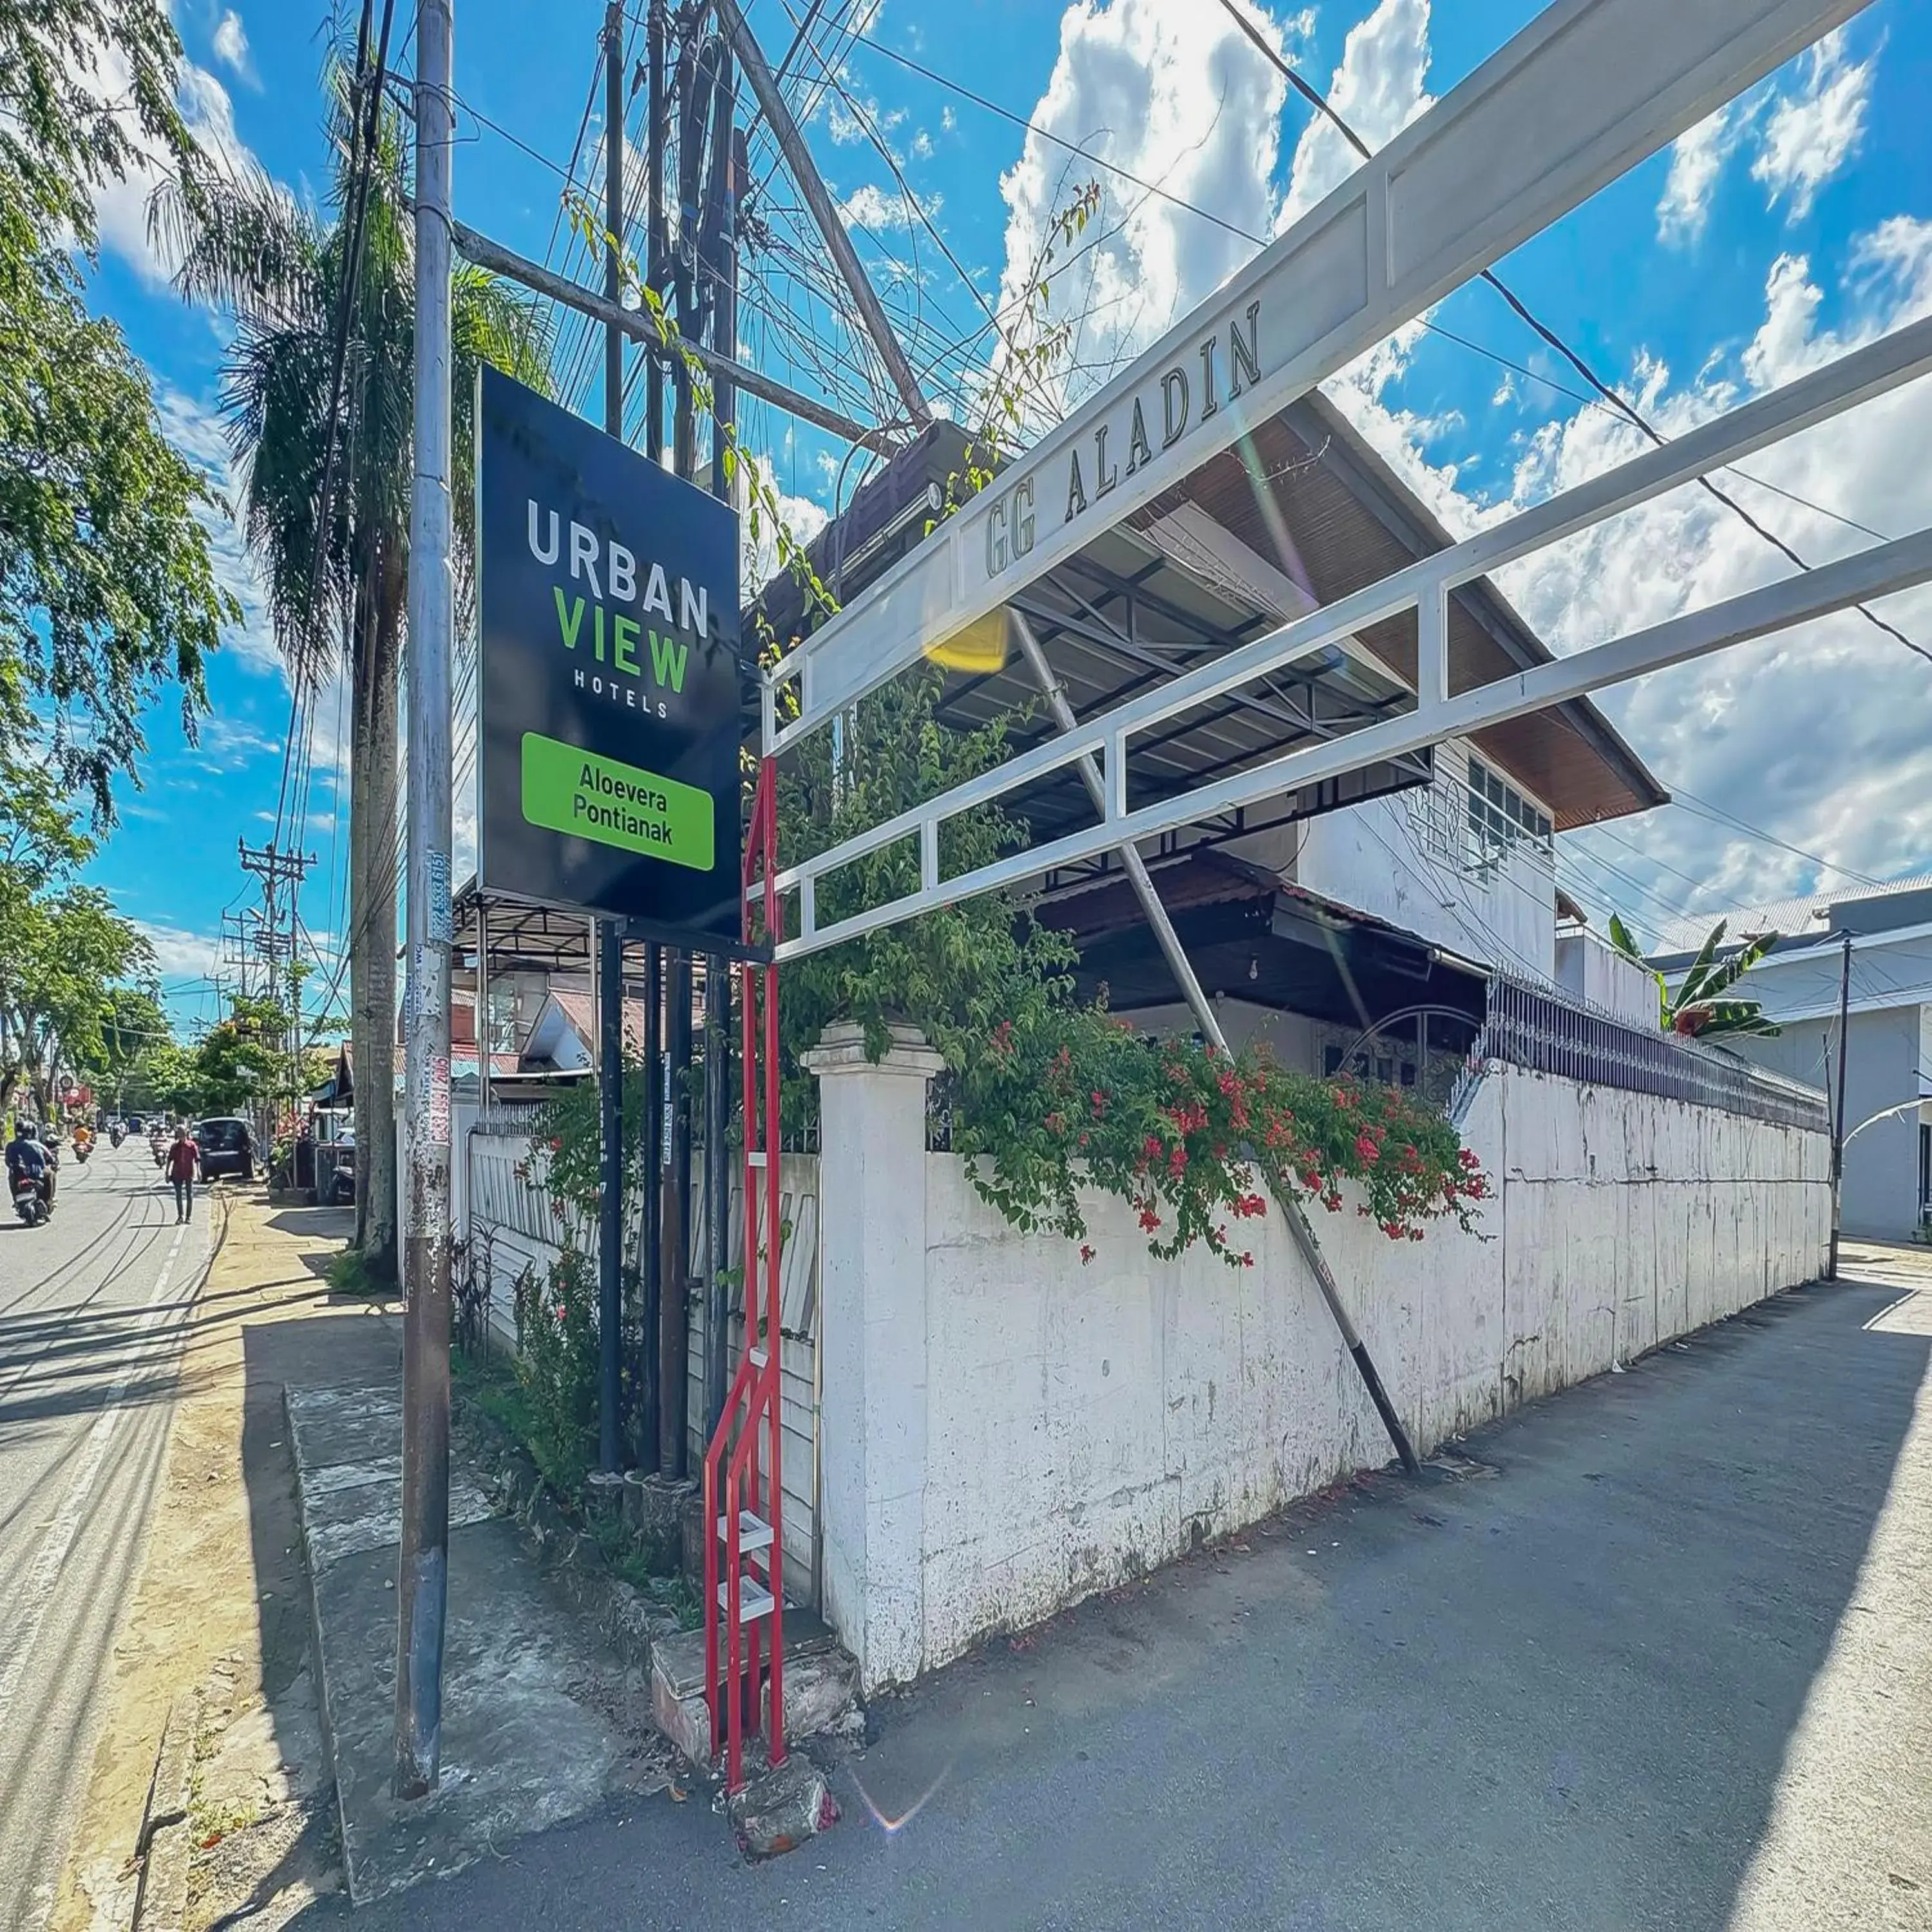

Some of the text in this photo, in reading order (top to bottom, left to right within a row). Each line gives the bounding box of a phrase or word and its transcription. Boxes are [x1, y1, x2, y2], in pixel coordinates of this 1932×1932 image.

[985, 300, 1261, 579] GG ALADIN
[527, 499, 708, 639] URBAN
[553, 587, 688, 694] VIEW
[574, 669, 667, 719] HOTELS
[579, 762, 667, 813] Aloevera
[573, 792, 673, 846] Pontianak
[431, 852, 445, 879] 6151
